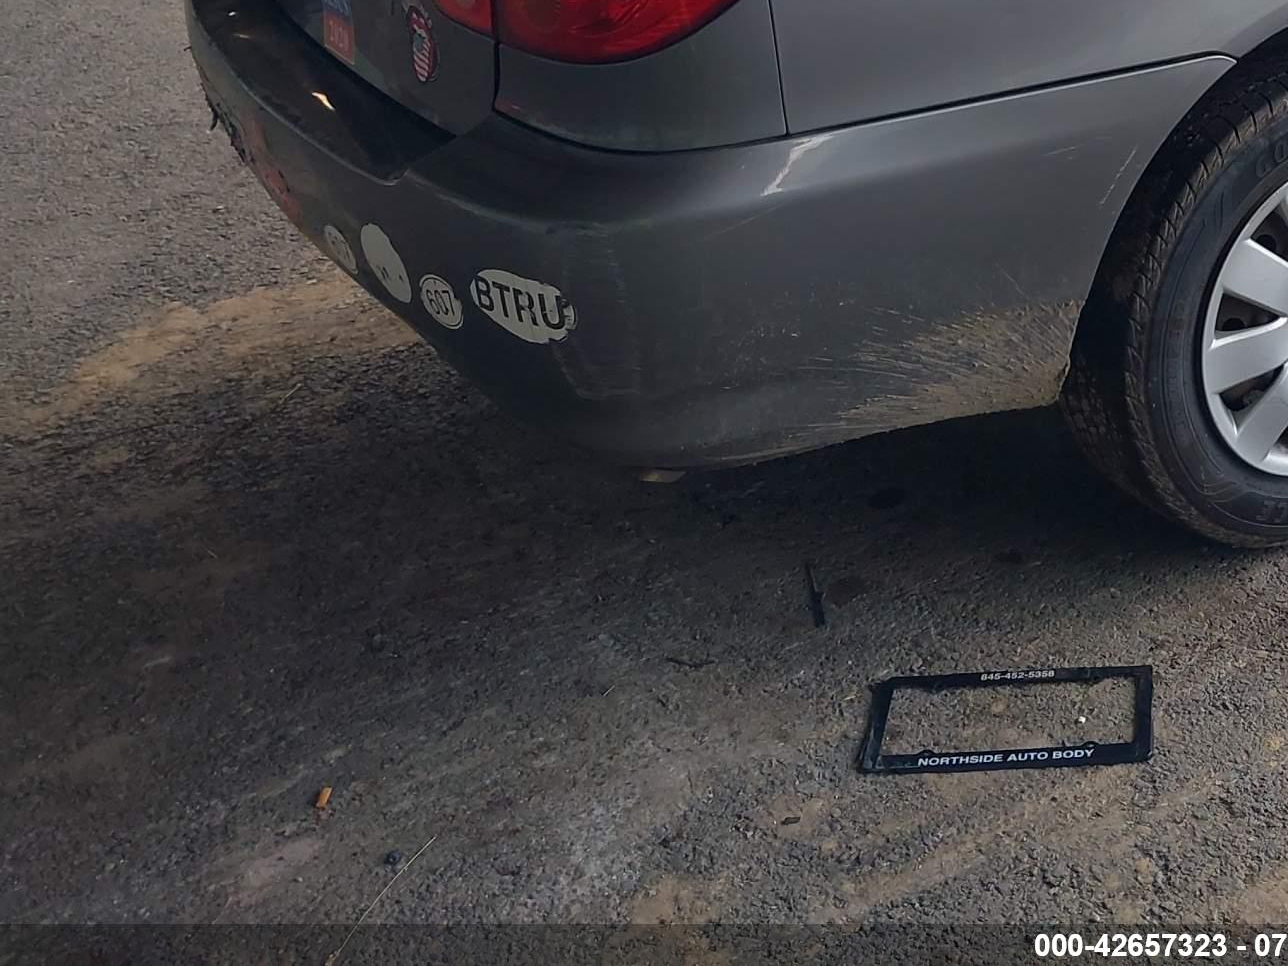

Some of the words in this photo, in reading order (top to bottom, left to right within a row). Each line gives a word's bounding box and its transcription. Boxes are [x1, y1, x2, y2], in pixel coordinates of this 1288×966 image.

[426, 289, 456, 316] 607
[917, 754, 1004, 767] NORTHSIDE
[1006, 752, 1049, 763] AUTO
[1052, 749, 1095, 760] BODY
